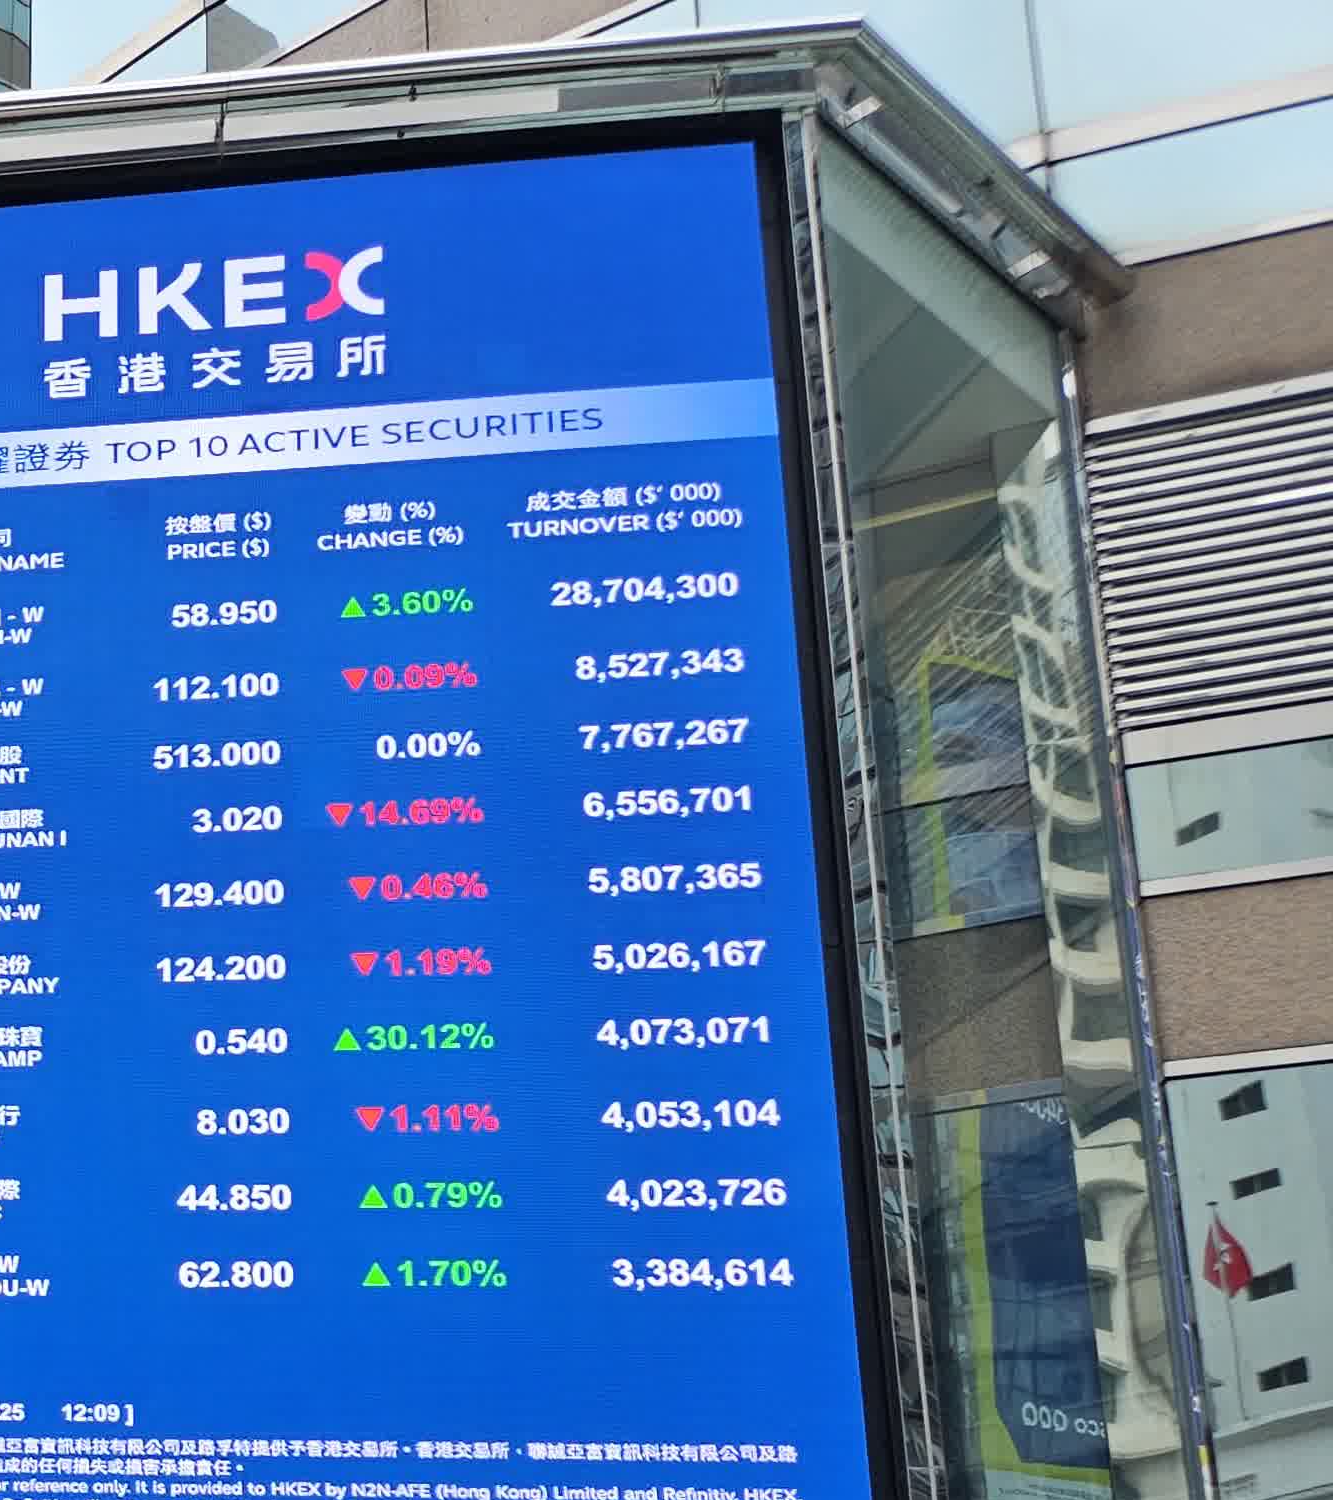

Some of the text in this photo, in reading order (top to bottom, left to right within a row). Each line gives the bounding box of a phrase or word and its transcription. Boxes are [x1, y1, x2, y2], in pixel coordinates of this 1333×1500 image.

[44, 246, 385, 344] HKEX
[44, 334, 385, 398] 香港交易所
[107, 440, 175, 463] TOP
[191, 436, 227, 457] 10
[239, 426, 368, 454] ACTIVE
[380, 404, 607, 448] SECURITIES
[345, 502, 435, 524] 變動 (%)
[526, 487, 628, 512] 成交金額
[165, 512, 271, 535] 按盤價 ($)
[507, 515, 649, 538] TURNOVER
[168, 538, 269, 560] PRICE ($)
[317, 526, 463, 550] CHANGE (%)
[371, 588, 474, 617] 3.60%
[551, 572, 739, 607] 28,704,300
[172, 600, 277, 627] 58.950
[373, 662, 478, 691] 0.09%
[576, 648, 744, 682] 8,527,343
[154, 673, 279, 701] 112.100
[377, 731, 480, 759] 0.00%
[579, 718, 749, 752] 7,767,267
[154, 741, 280, 769] 513.000
[360, 797, 484, 826] 14.69%
[583, 786, 750, 820] 6,556,701
[193, 806, 282, 832] 3.020
[155, 880, 284, 907] 129.400
[381, 872, 488, 901] 0.46%
[589, 863, 761, 896] 5,807,365
[157, 954, 286, 982] 124.200
[385, 947, 492, 976] 1.19%
[593, 940, 765, 973] 5,026,167
[196, 1028, 287, 1055] 0.540
[367, 1022, 494, 1050] 30.12%
[597, 1016, 768, 1049] 4,073,071
[197, 1108, 289, 1135] 8.030
[390, 1104, 499, 1132] 1.11%
[601, 1099, 780, 1132] 4,053,104
[177, 1184, 291, 1210] 44.850
[392, 1180, 502, 1208] 0.79%
[607, 1178, 786, 1211] 4,023,726
[179, 1261, 293, 1288] 62.800
[398, 1259, 508, 1286] 1.70%
[613, 1259, 794, 1291] 3,384,614
[62, 1404, 120, 1422] 12:09
[13, 1479, 88, 1493] reference
[92, 1480, 130, 1497] only.
